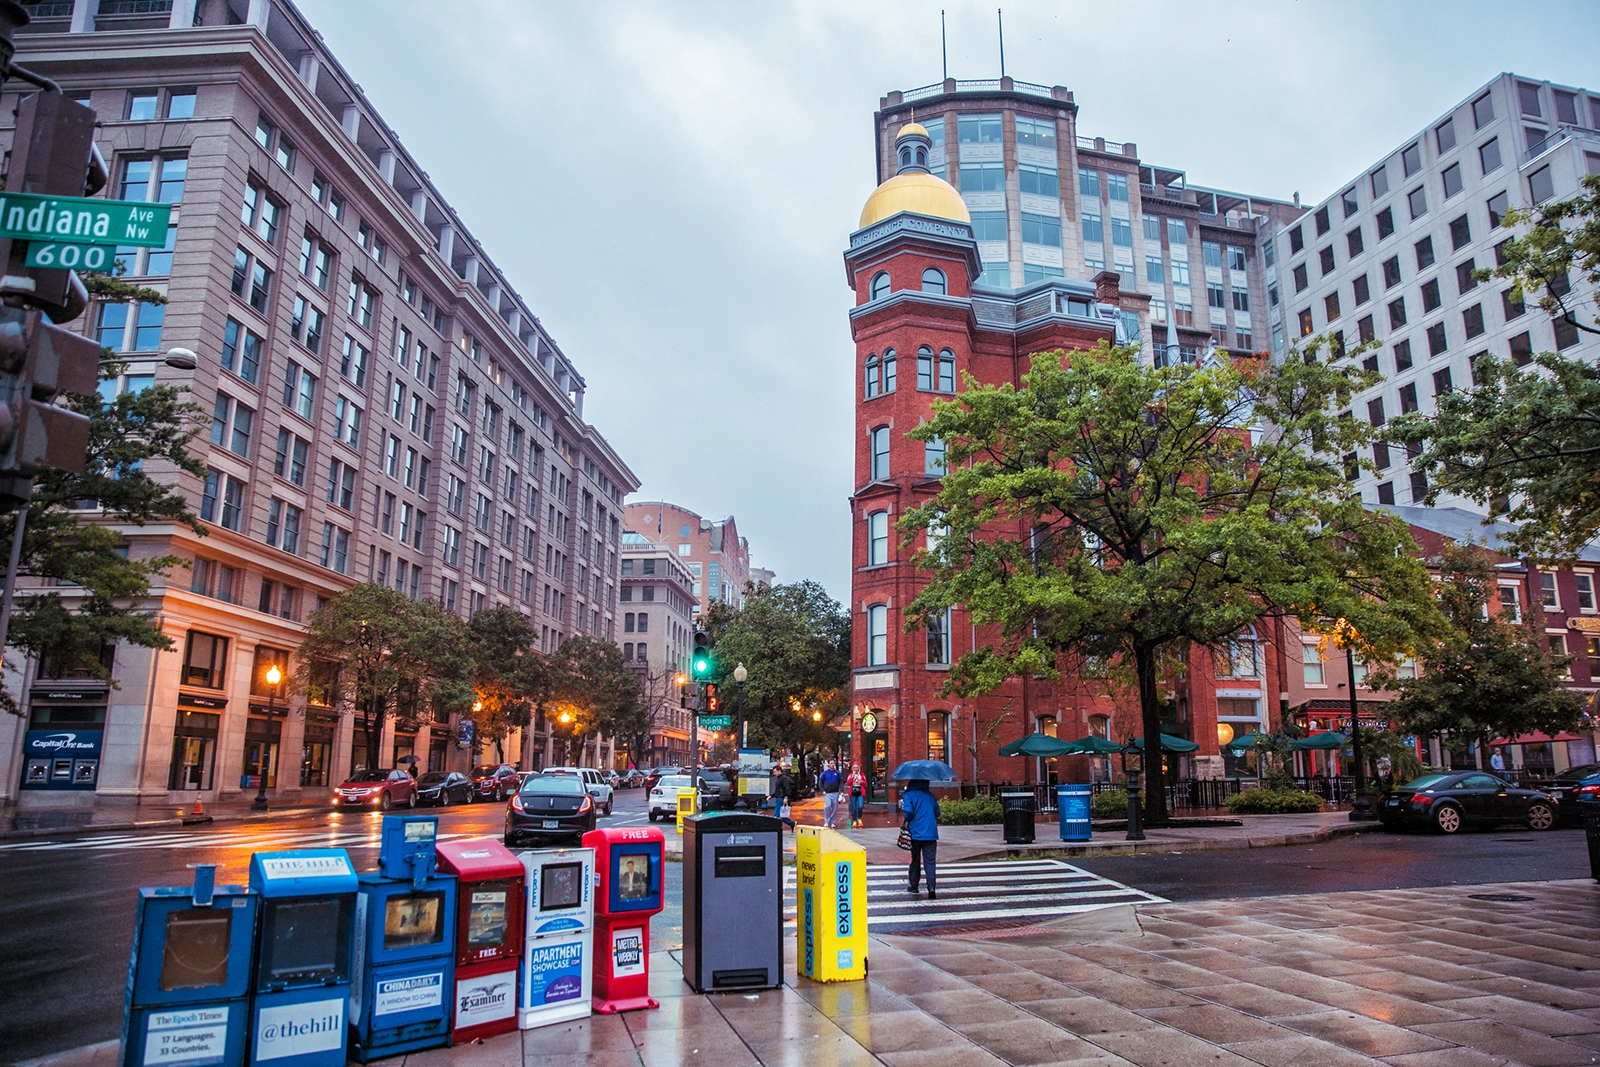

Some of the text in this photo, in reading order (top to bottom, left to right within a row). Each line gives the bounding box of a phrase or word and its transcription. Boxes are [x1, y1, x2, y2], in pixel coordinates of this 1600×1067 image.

[129, 207, 154, 222] Ave
[126, 224, 149, 239] Nw
[851, 219, 965, 246] INSURANCE COMPANY
[35, 244, 105, 269] 600
[710, 698, 716, 710] 2
[622, 830, 649, 839] FREE
[306, 859, 345, 867] HILL
[802, 861, 816, 872] news
[802, 872, 816, 885] brief
[838, 864, 851, 935] express
[534, 910, 586, 921] ApartmentShowcase.com
[805, 892, 814, 973] express
[479, 948, 497, 958] FREE
[533, 944, 581, 963] APARTMENT
[533, 959, 569, 973] SHOWCASE
[387, 996, 411, 1005] WINDOW
[460, 993, 507, 1013] Examiner
[156, 1011, 223, 1025] The Epoch Times
[261, 1015, 339, 1043] @thehill
[162, 1032, 216, 1043] 17 Languages.
[160, 1043, 211, 1055] 33 Countries.
